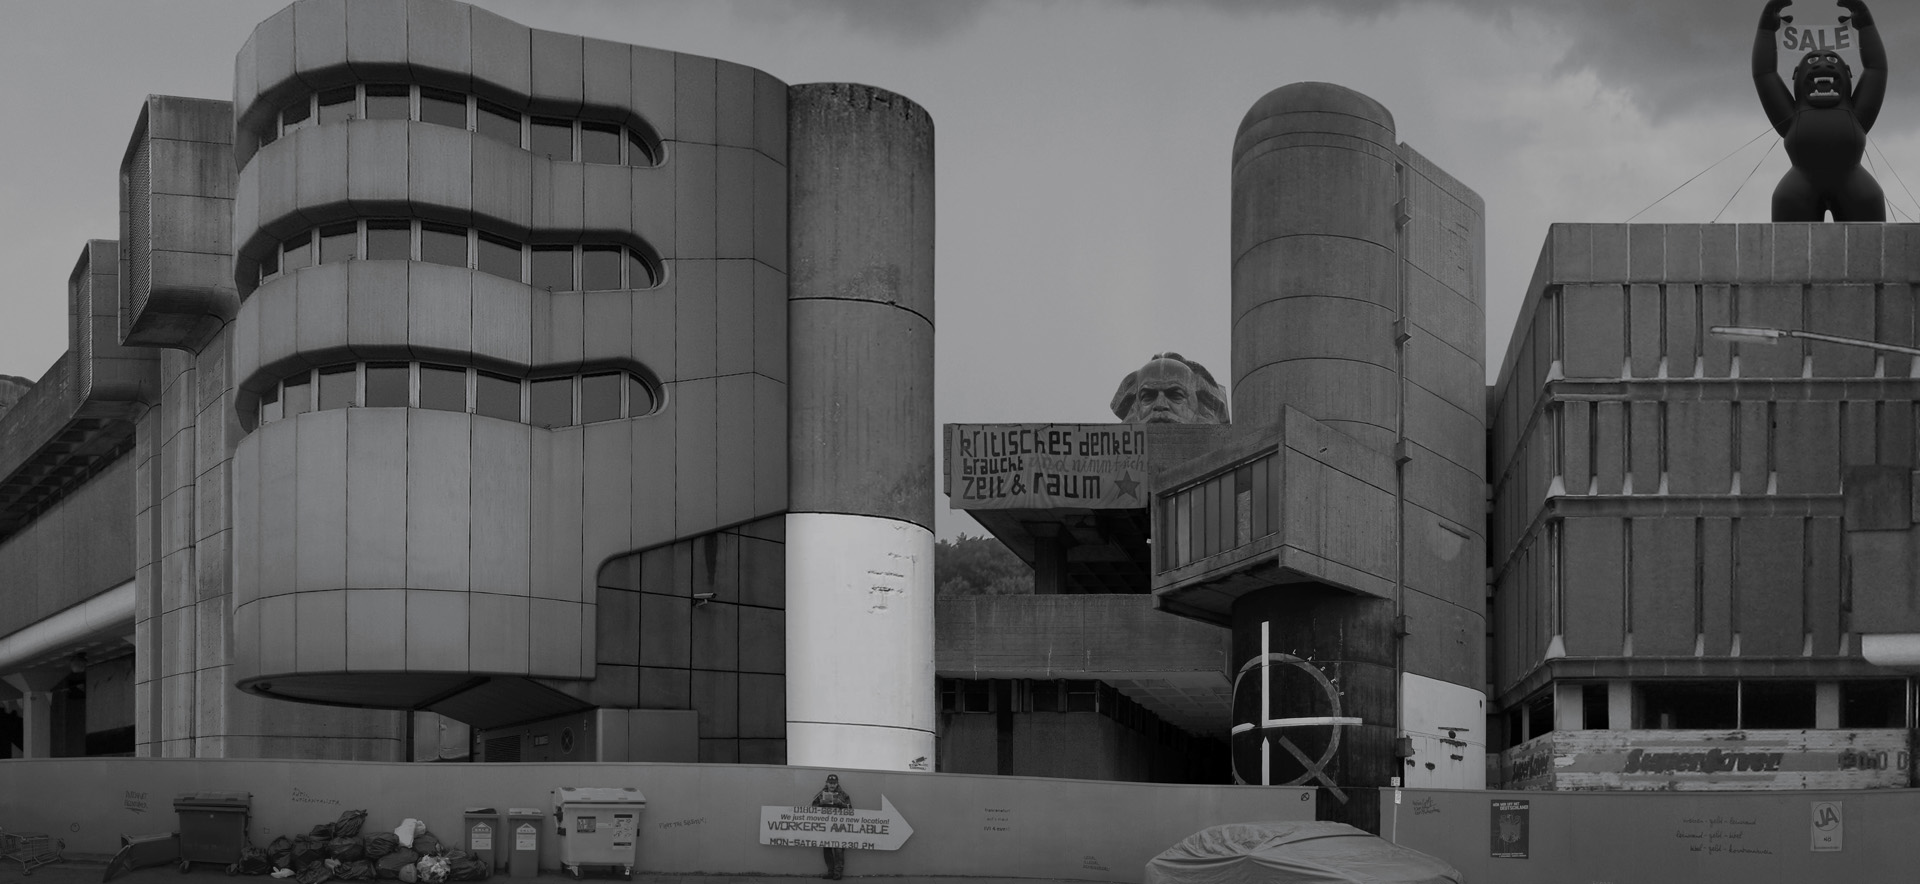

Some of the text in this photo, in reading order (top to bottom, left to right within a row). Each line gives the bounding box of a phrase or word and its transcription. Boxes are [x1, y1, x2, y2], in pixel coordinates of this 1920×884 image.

[1783, 26, 1850, 51] SALE
[960, 429, 1145, 457] kritisches denken
[963, 456, 1024, 475] braucht
[962, 472, 1100, 499] zeit & raum
[792, 814, 805, 822] just
[806, 814, 829, 822] moved
[831, 815, 838, 823] to
[861, 817, 890, 825] location!
[1815, 807, 1839, 828] JA
[767, 821, 890, 835] WORKERS AVAILABLE
[862, 842, 875, 850] PM
